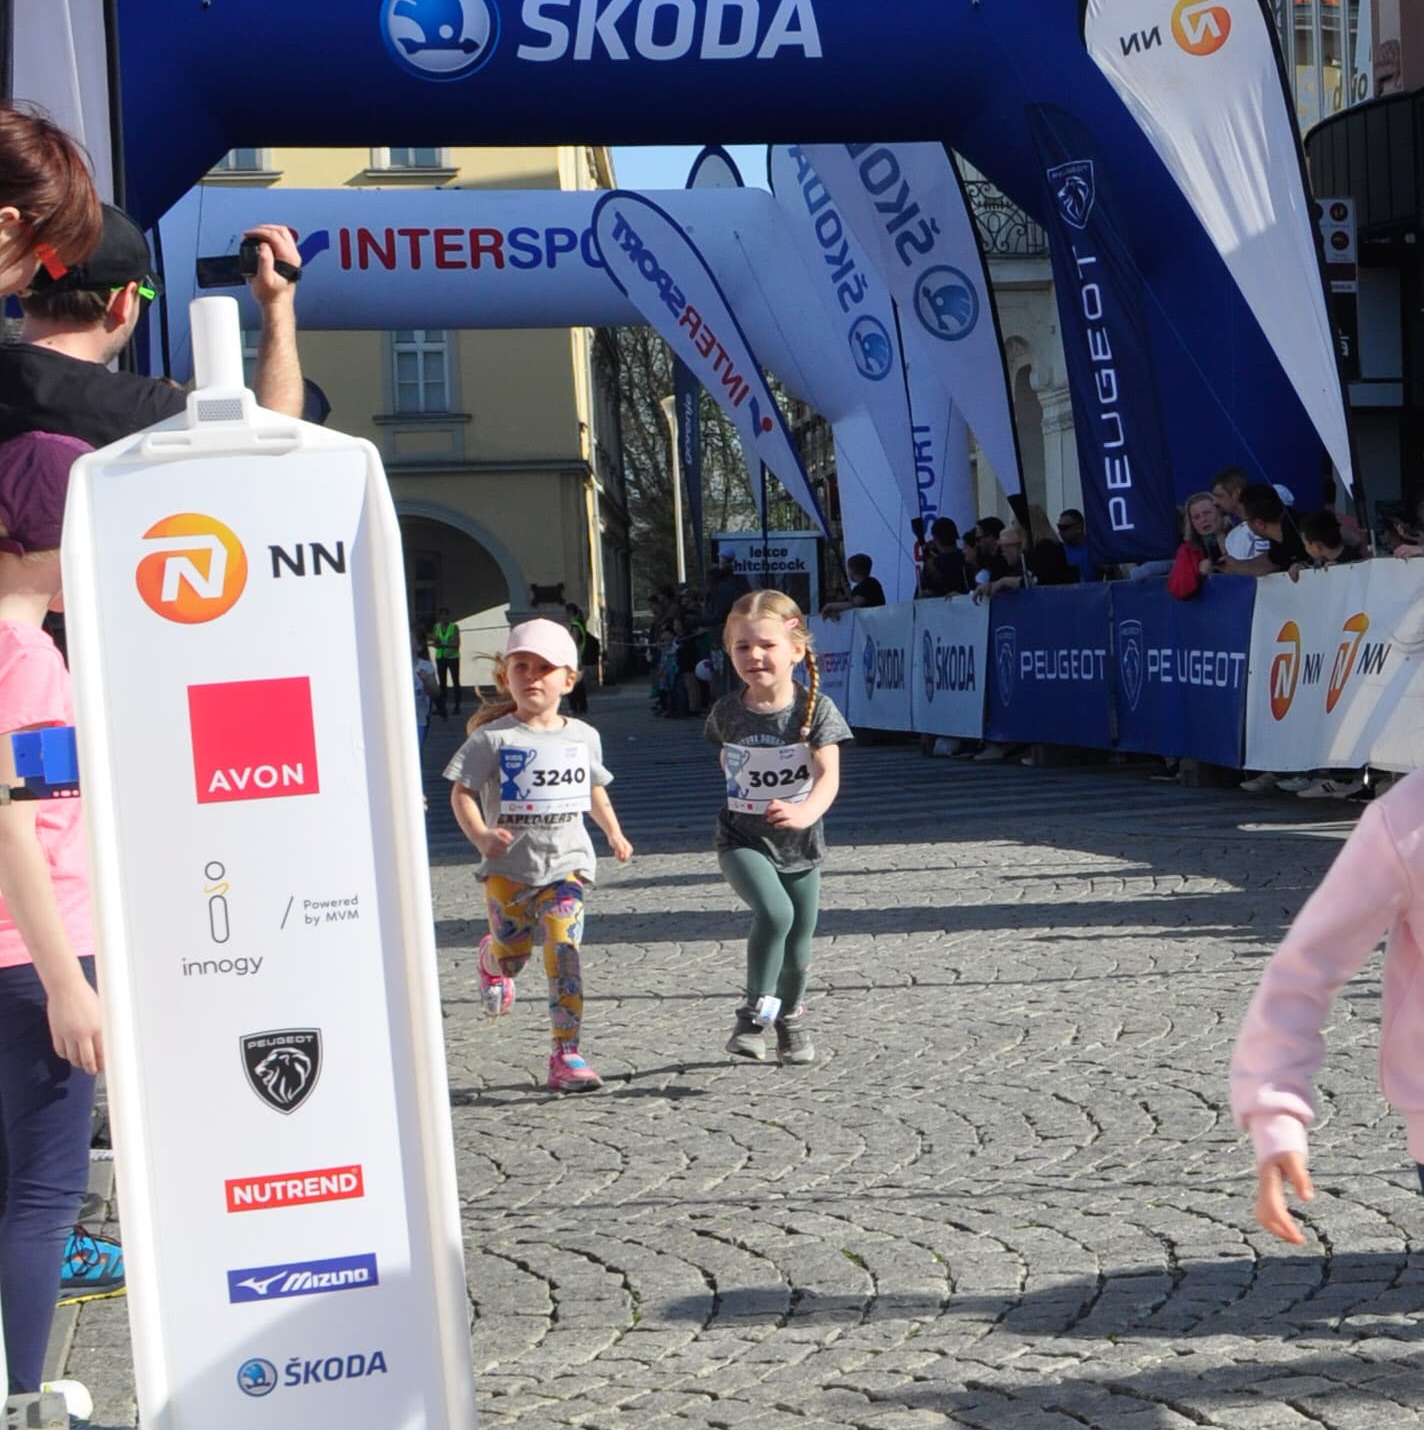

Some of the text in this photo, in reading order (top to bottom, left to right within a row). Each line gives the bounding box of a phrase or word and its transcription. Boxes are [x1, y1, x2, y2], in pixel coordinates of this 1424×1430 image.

[1071, 244, 1135, 532] PEUGEOT
[267, 540, 347, 579] NN
[876, 640, 906, 691] ŠKODA
[934, 636, 976, 692] ŠKODA
[1020, 649, 1106, 680] PEUGEOT
[1147, 648, 1247, 689] PEUGEOT
[1302, 652, 1326, 686] NN
[1356, 642, 1393, 675] NN
[207, 763, 305, 794] AVON
[531, 767, 586, 788] 3240
[749, 764, 811, 788] 3024
[303, 895, 359, 911] Powered
[304, 909, 360, 926] by MVM
[181, 956, 264, 977] innogy
[247, 1034, 315, 1050] PEUGEOT
[232, 1172, 358, 1206] NUTREND
[284, 1350, 389, 1388] ŠKODA
